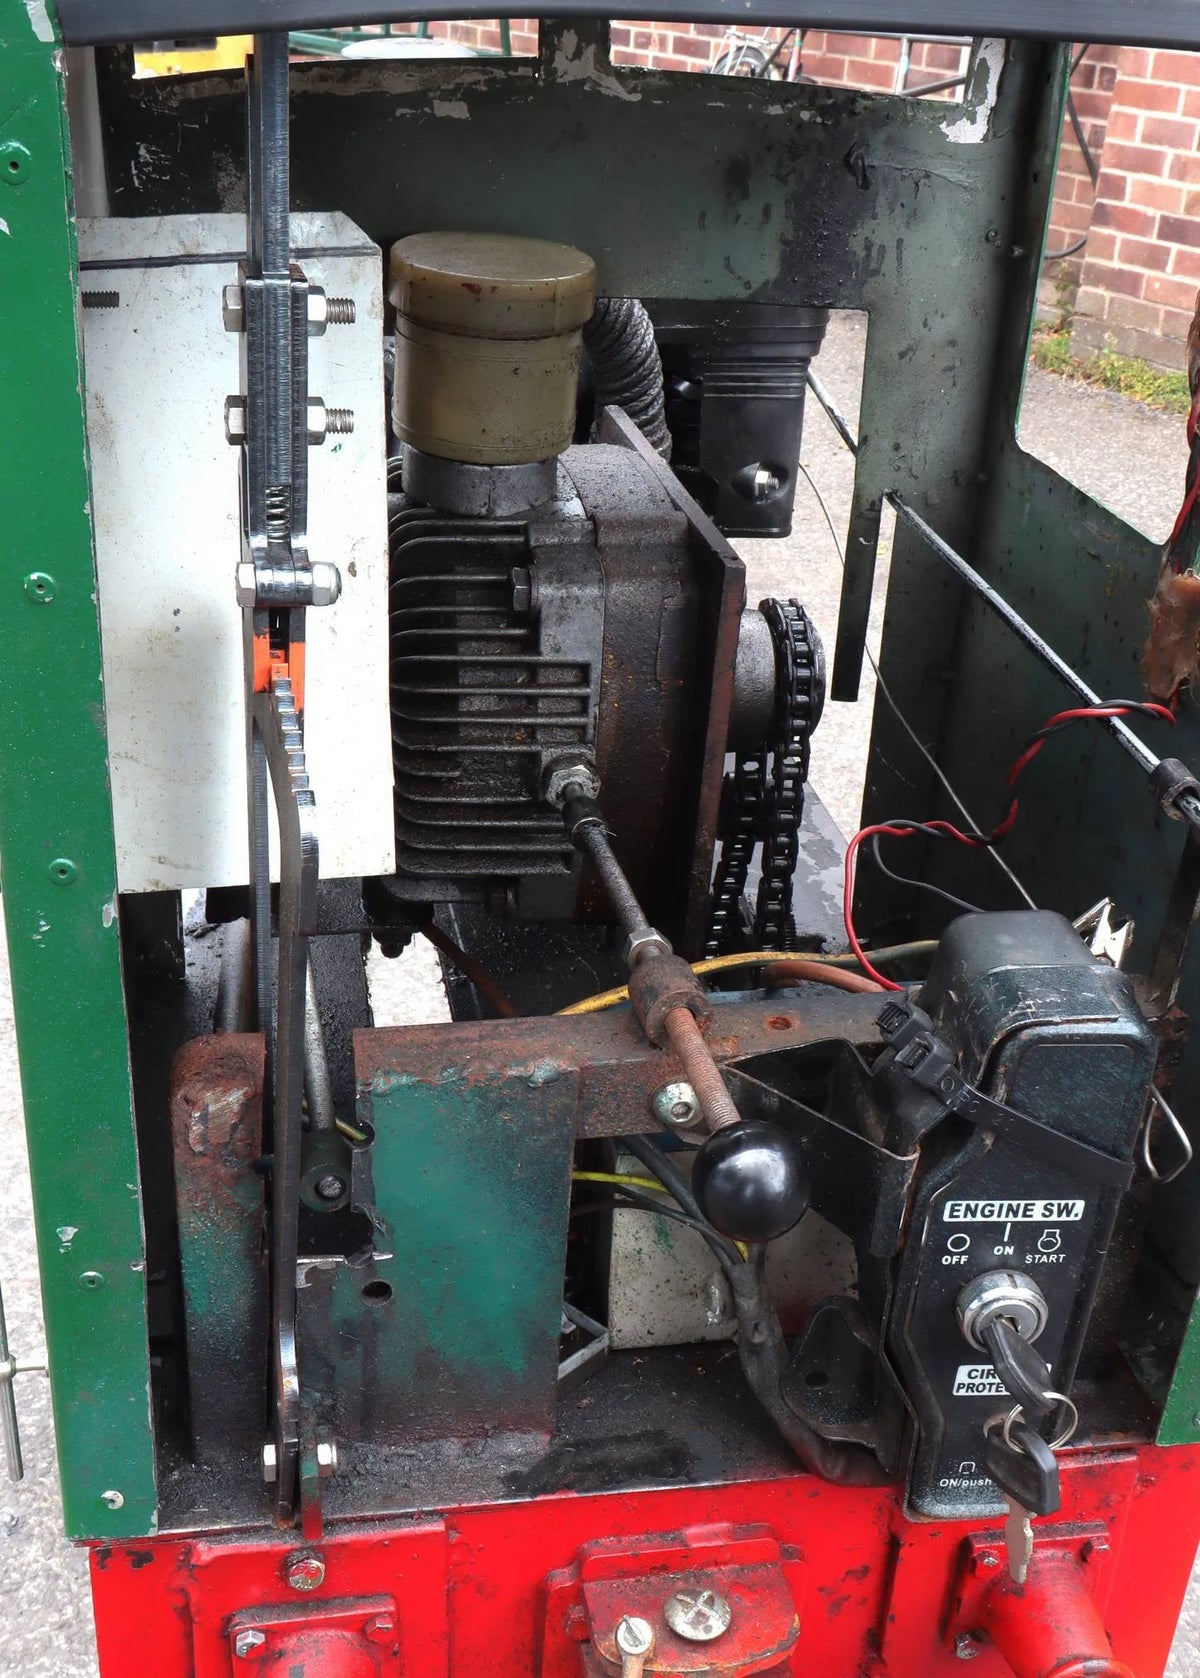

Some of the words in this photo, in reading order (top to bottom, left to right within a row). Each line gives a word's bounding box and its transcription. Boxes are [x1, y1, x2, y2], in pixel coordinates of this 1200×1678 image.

[948, 1202, 1035, 1218] ENGINE
[1041, 1202, 1079, 1218] SW.
[993, 1245, 1015, 1255] ON
[941, 1255, 969, 1265] OFF
[1025, 1253, 1066, 1264] START
[955, 1382, 1005, 1393] PROTE
[940, 1478, 992, 1488] ON/push
